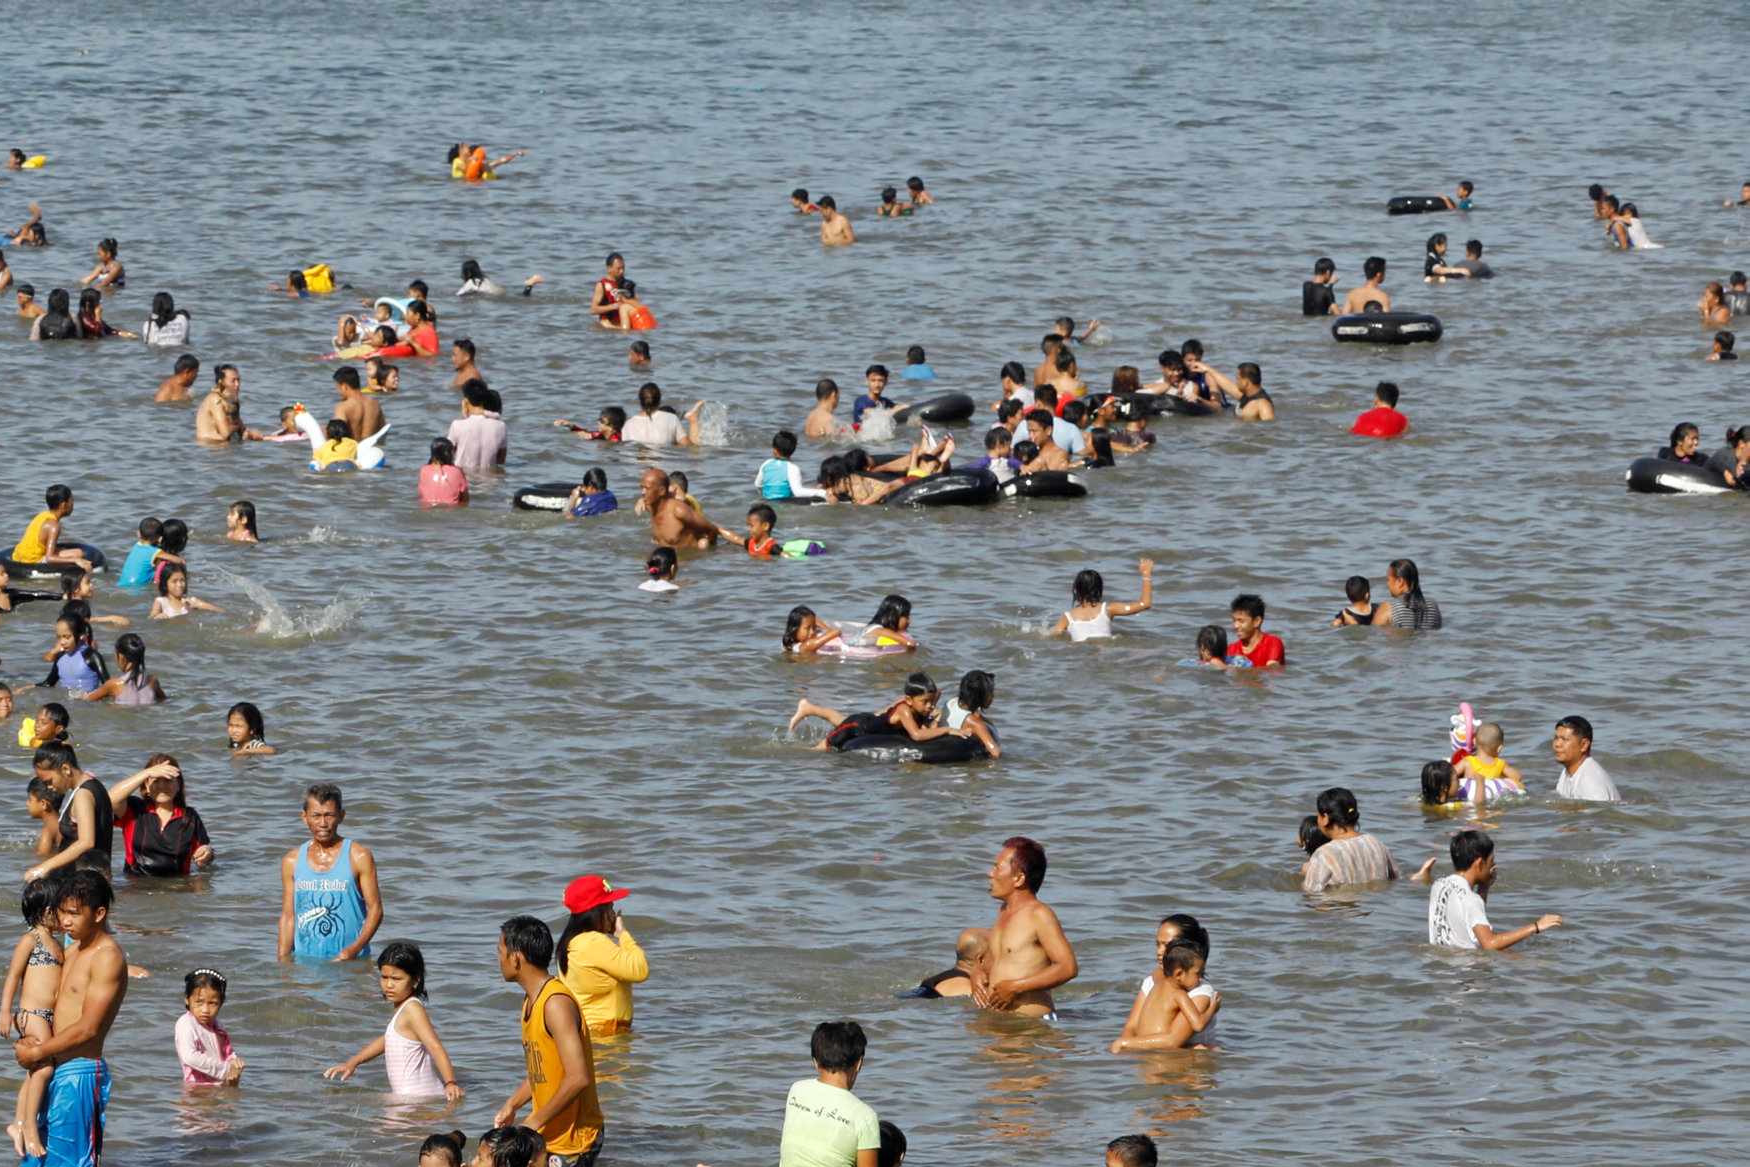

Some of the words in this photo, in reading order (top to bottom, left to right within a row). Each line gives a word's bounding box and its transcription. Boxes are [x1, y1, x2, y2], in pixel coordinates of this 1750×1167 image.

[296, 879, 317, 891] Soul
[319, 879, 349, 891] Rebel
[788, 1096, 812, 1114] Queen
[814, 1106, 825, 1117] of
[826, 1108, 851, 1126] Love
